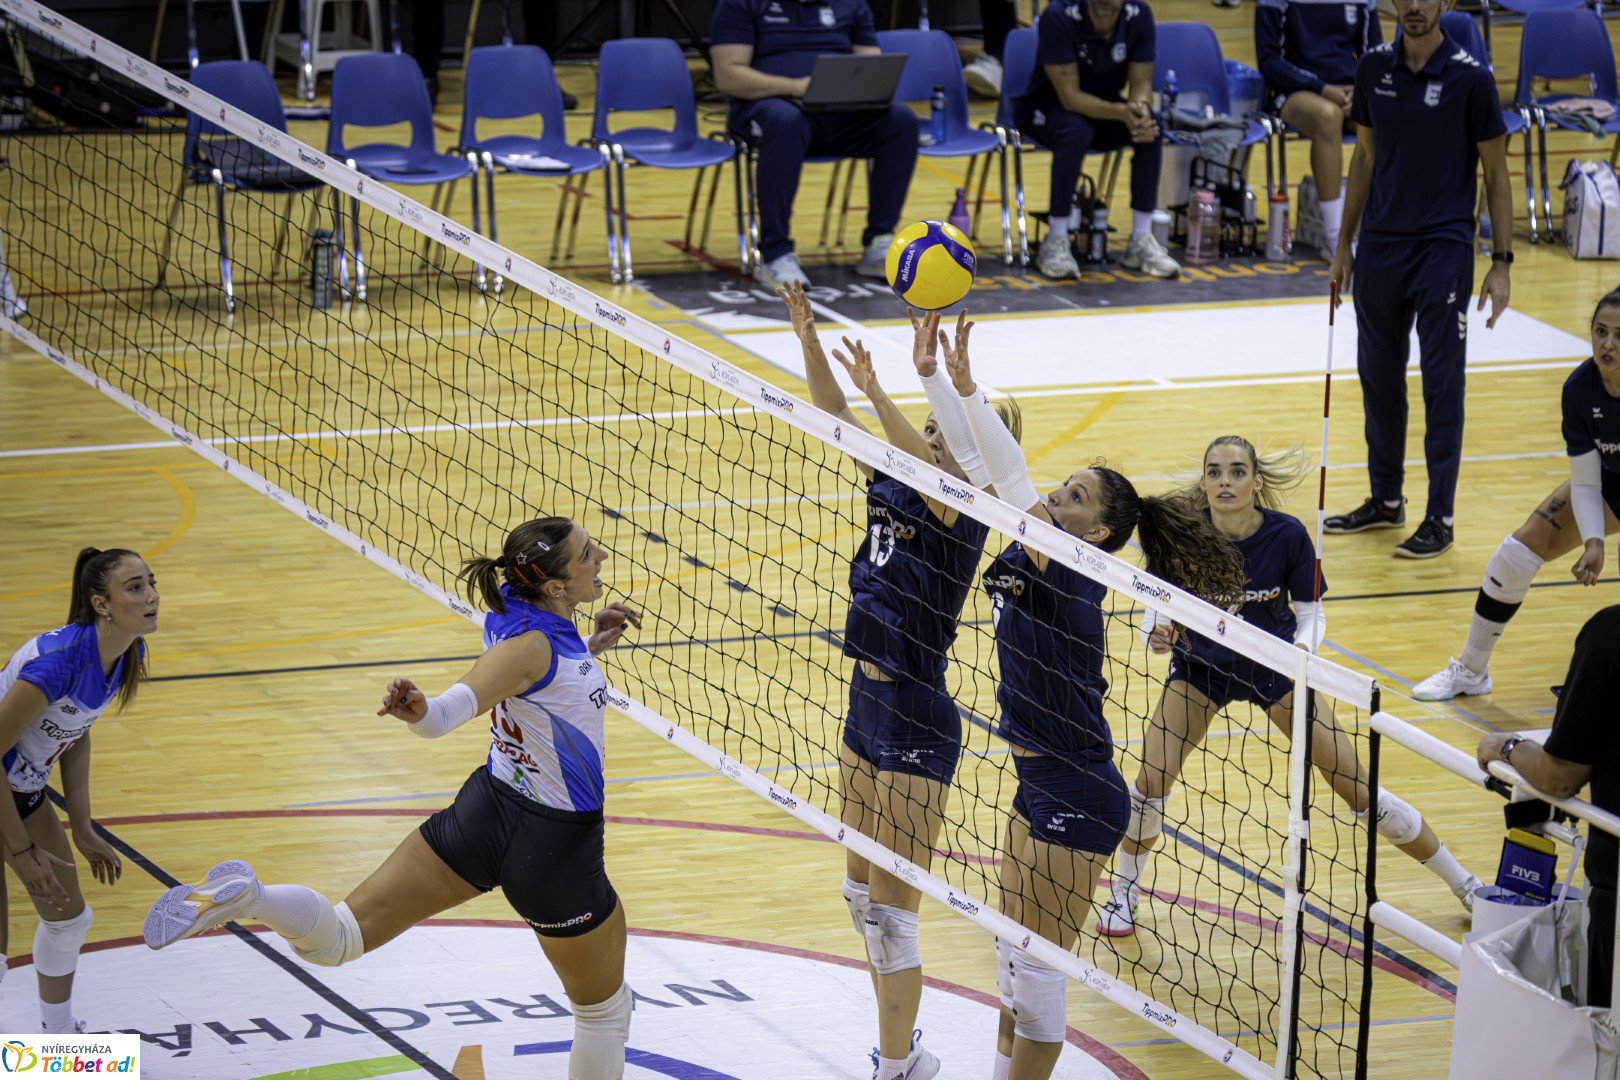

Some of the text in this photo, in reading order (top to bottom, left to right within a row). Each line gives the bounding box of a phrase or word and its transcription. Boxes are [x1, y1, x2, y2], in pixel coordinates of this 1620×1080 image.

[901, 249, 915, 282] MIKASA
[971, 259, 1332, 291] Continenta
[869, 524, 895, 567] 13
[1511, 864, 1541, 882] FIVB
[88, 979, 756, 1058] NYREGYHÁ
